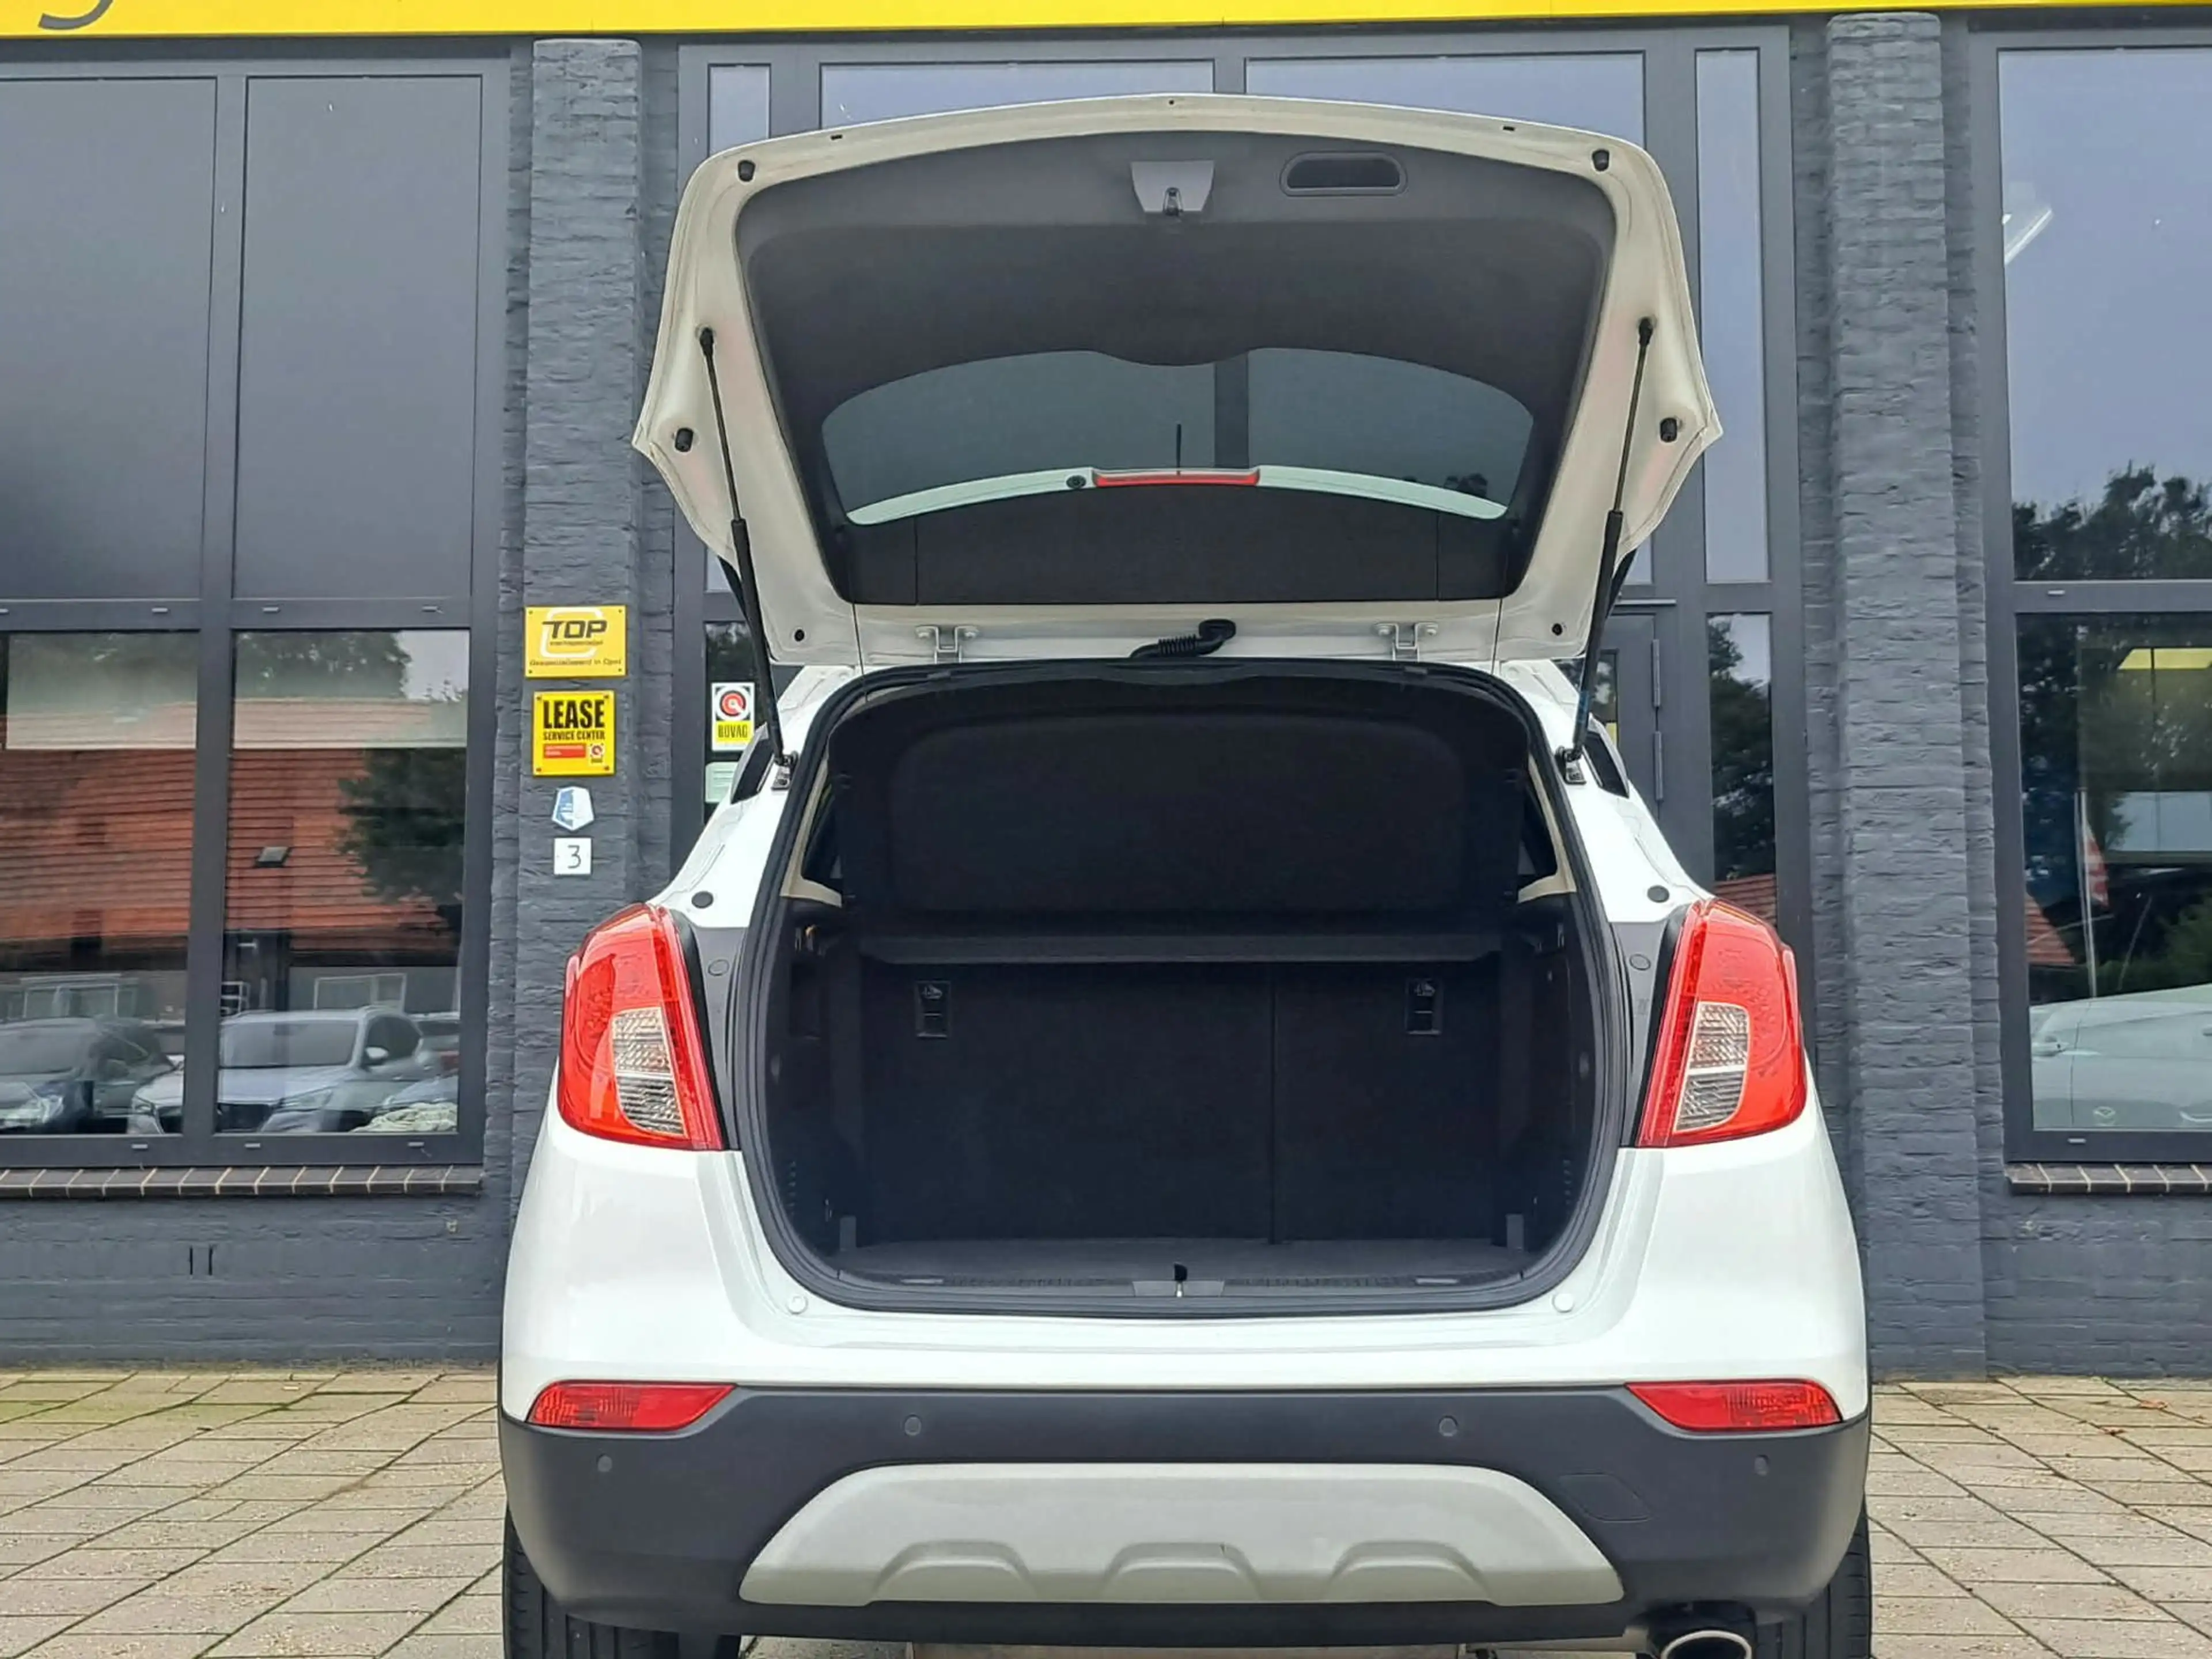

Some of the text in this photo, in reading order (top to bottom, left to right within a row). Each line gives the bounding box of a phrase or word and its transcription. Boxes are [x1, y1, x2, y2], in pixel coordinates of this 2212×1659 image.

[542, 620, 608, 639] TOP
[543, 699, 605, 729] LEASE
[543, 730, 605, 741] SERVICE CENTER
[718, 724, 748, 738] BOVAG
[567, 844, 582, 869] 3
